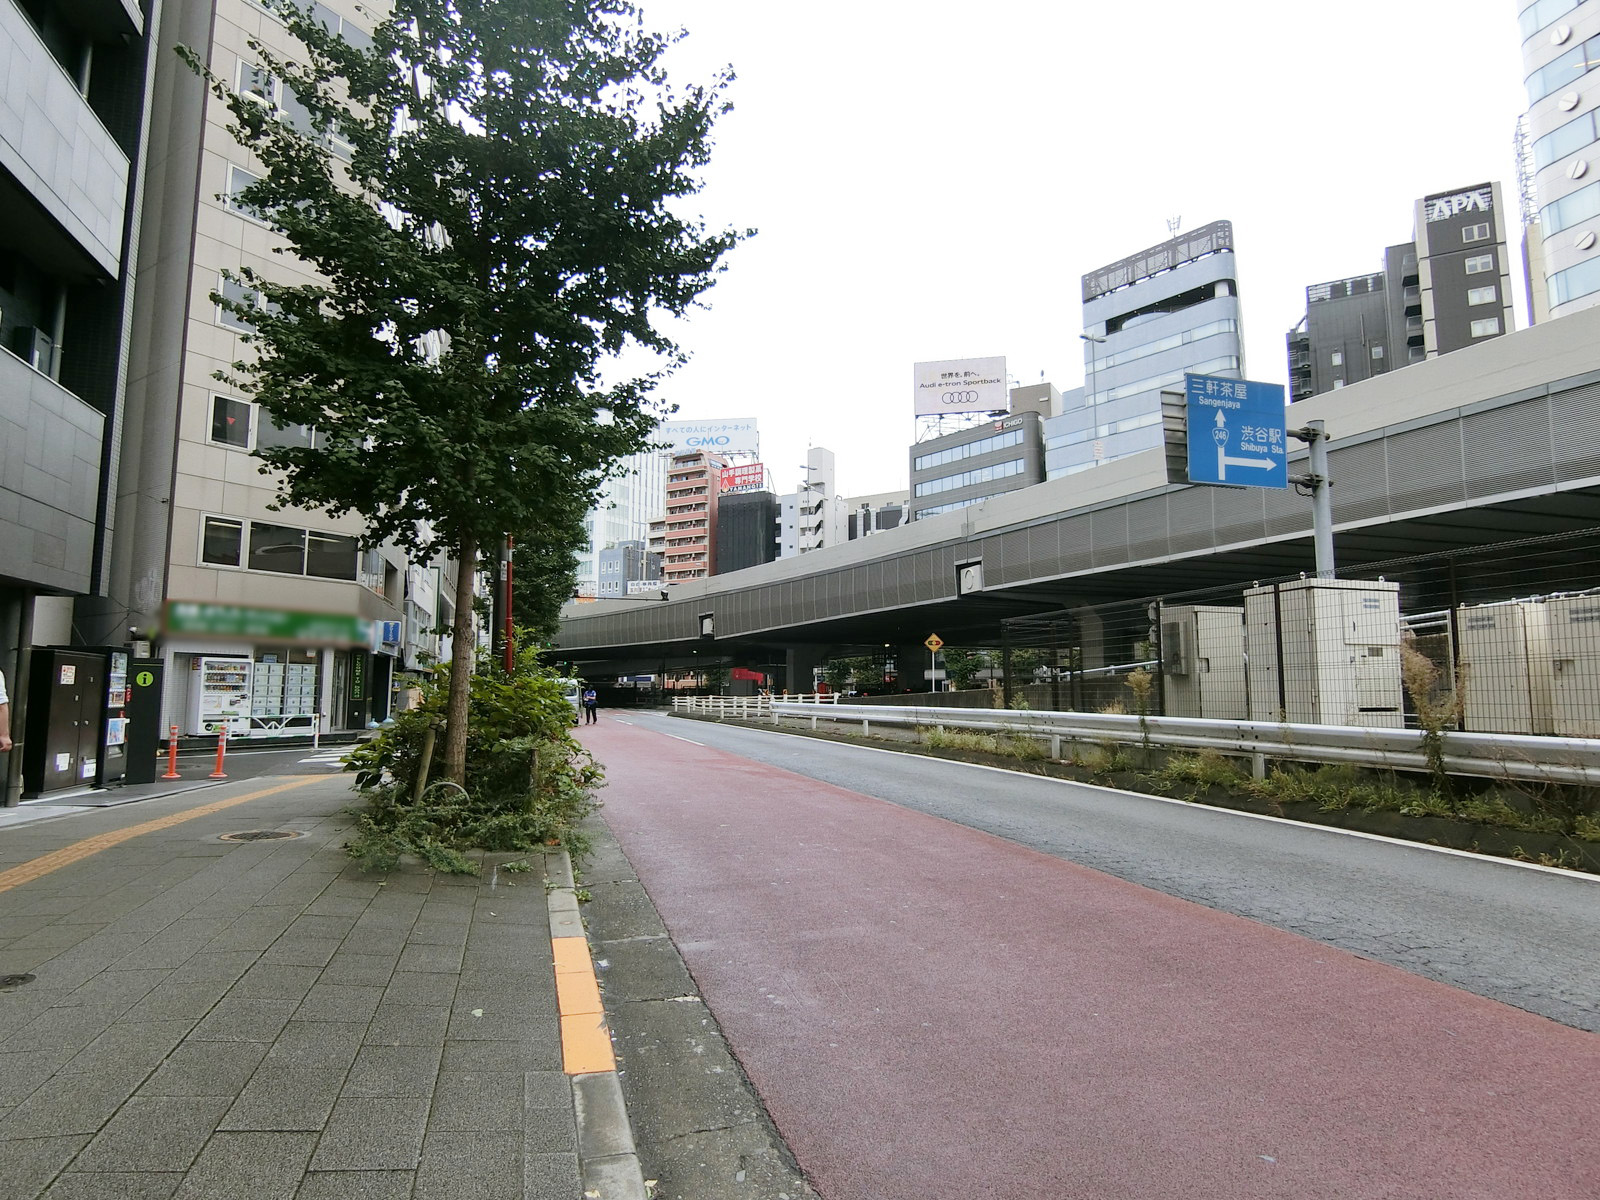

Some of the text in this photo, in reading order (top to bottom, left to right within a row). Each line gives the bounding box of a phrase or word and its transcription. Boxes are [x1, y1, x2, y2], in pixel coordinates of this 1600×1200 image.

[1432, 192, 1488, 219] APA
[963, 378, 1002, 387] Sportback
[1191, 378, 1248, 400] 三軒茶屋
[1198, 395, 1241, 410] Sangenjaya
[686, 436, 730, 447] GMO
[1214, 430, 1227, 440] 246
[1241, 425, 1283, 444] 渋谷駅
[1240, 441, 1268, 454] Shibuya
